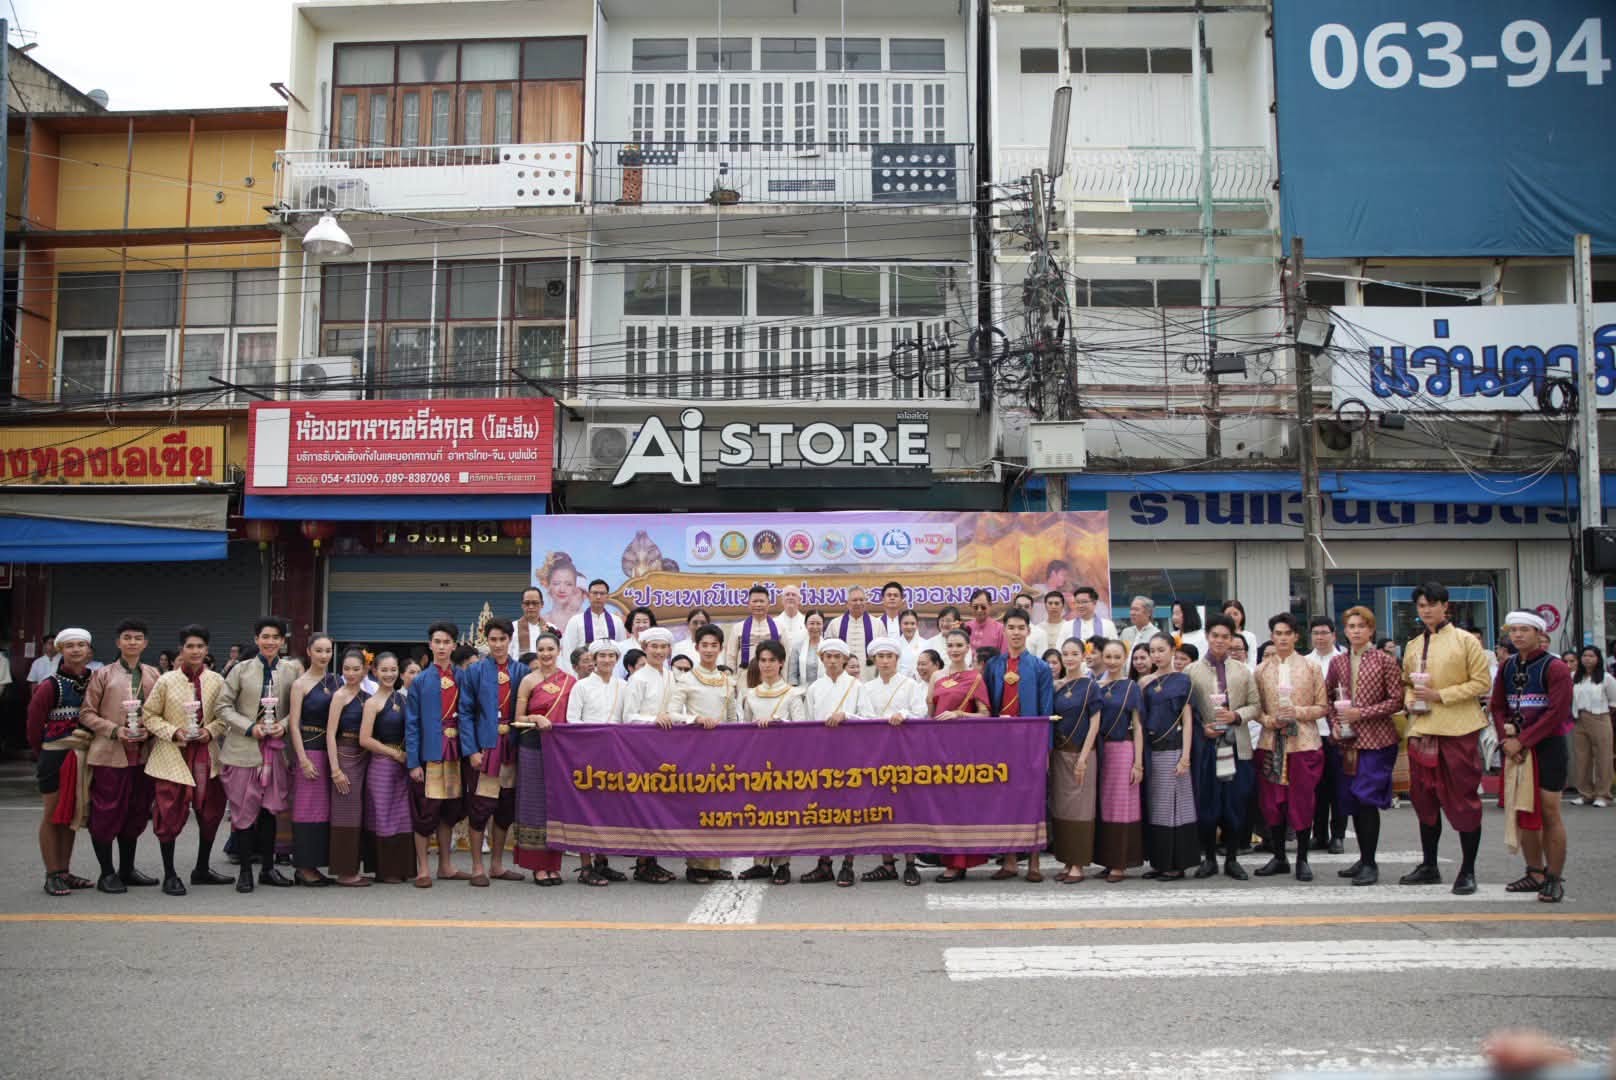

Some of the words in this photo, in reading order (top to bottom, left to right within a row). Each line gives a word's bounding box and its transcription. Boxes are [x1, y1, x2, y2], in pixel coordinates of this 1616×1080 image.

[1310, 18, 1612, 89] 063-94
[296, 407, 474, 448] ห้องอาหารศรีสกุล
[612, 407, 702, 485] Ai
[717, 421, 931, 468] STORE
[320, 473, 379, 483] 054-431096
[572, 761, 1010, 793] ประเพณีแห่ผ้าห่มพระธาตุจอมทอง
[699, 802, 894, 828] มหาวิทยาลัยพะเยา
